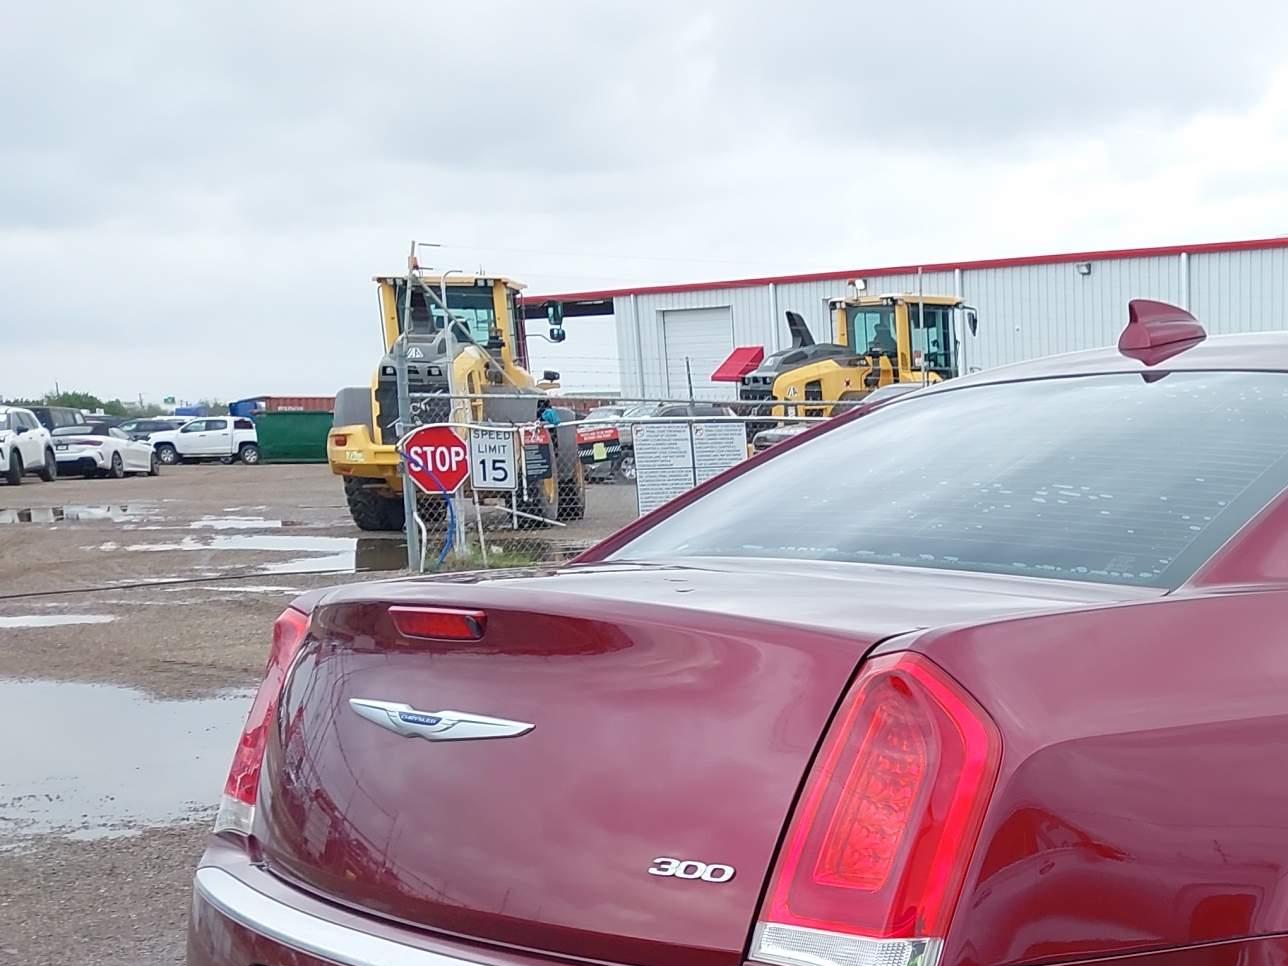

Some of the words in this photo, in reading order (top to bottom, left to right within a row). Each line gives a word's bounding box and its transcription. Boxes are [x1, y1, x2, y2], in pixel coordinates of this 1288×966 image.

[473, 430, 511, 440] SPEED
[410, 446, 464, 472] STOP
[478, 445, 507, 454] LIMIT
[479, 459, 508, 481] 15
[648, 857, 736, 883] 300
